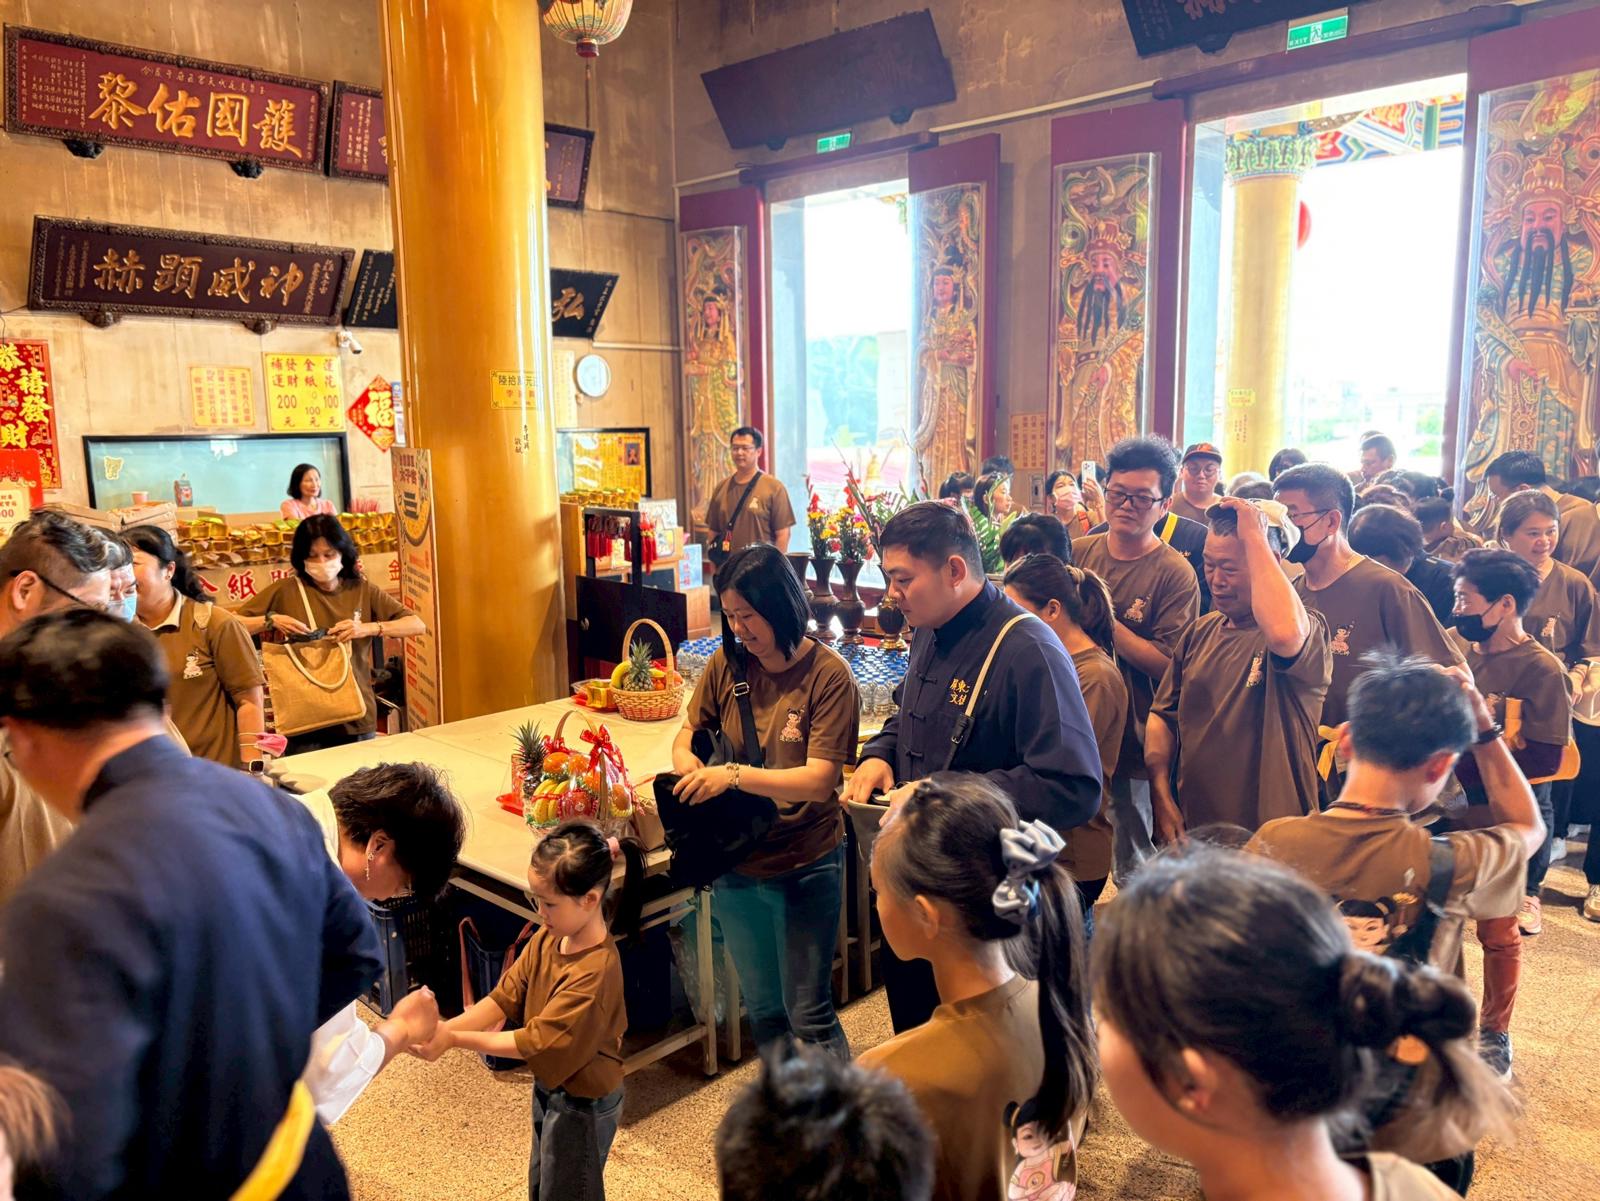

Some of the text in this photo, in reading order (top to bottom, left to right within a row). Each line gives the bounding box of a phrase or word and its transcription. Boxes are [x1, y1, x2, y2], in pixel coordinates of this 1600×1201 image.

[89, 71, 303, 158] 護國佑黎
[93, 248, 305, 307] 神威顯赫
[277, 395, 297, 409] 200
[305, 406, 320, 415] 100
[323, 395, 339, 409] 100
[365, 391, 394, 427] 福
